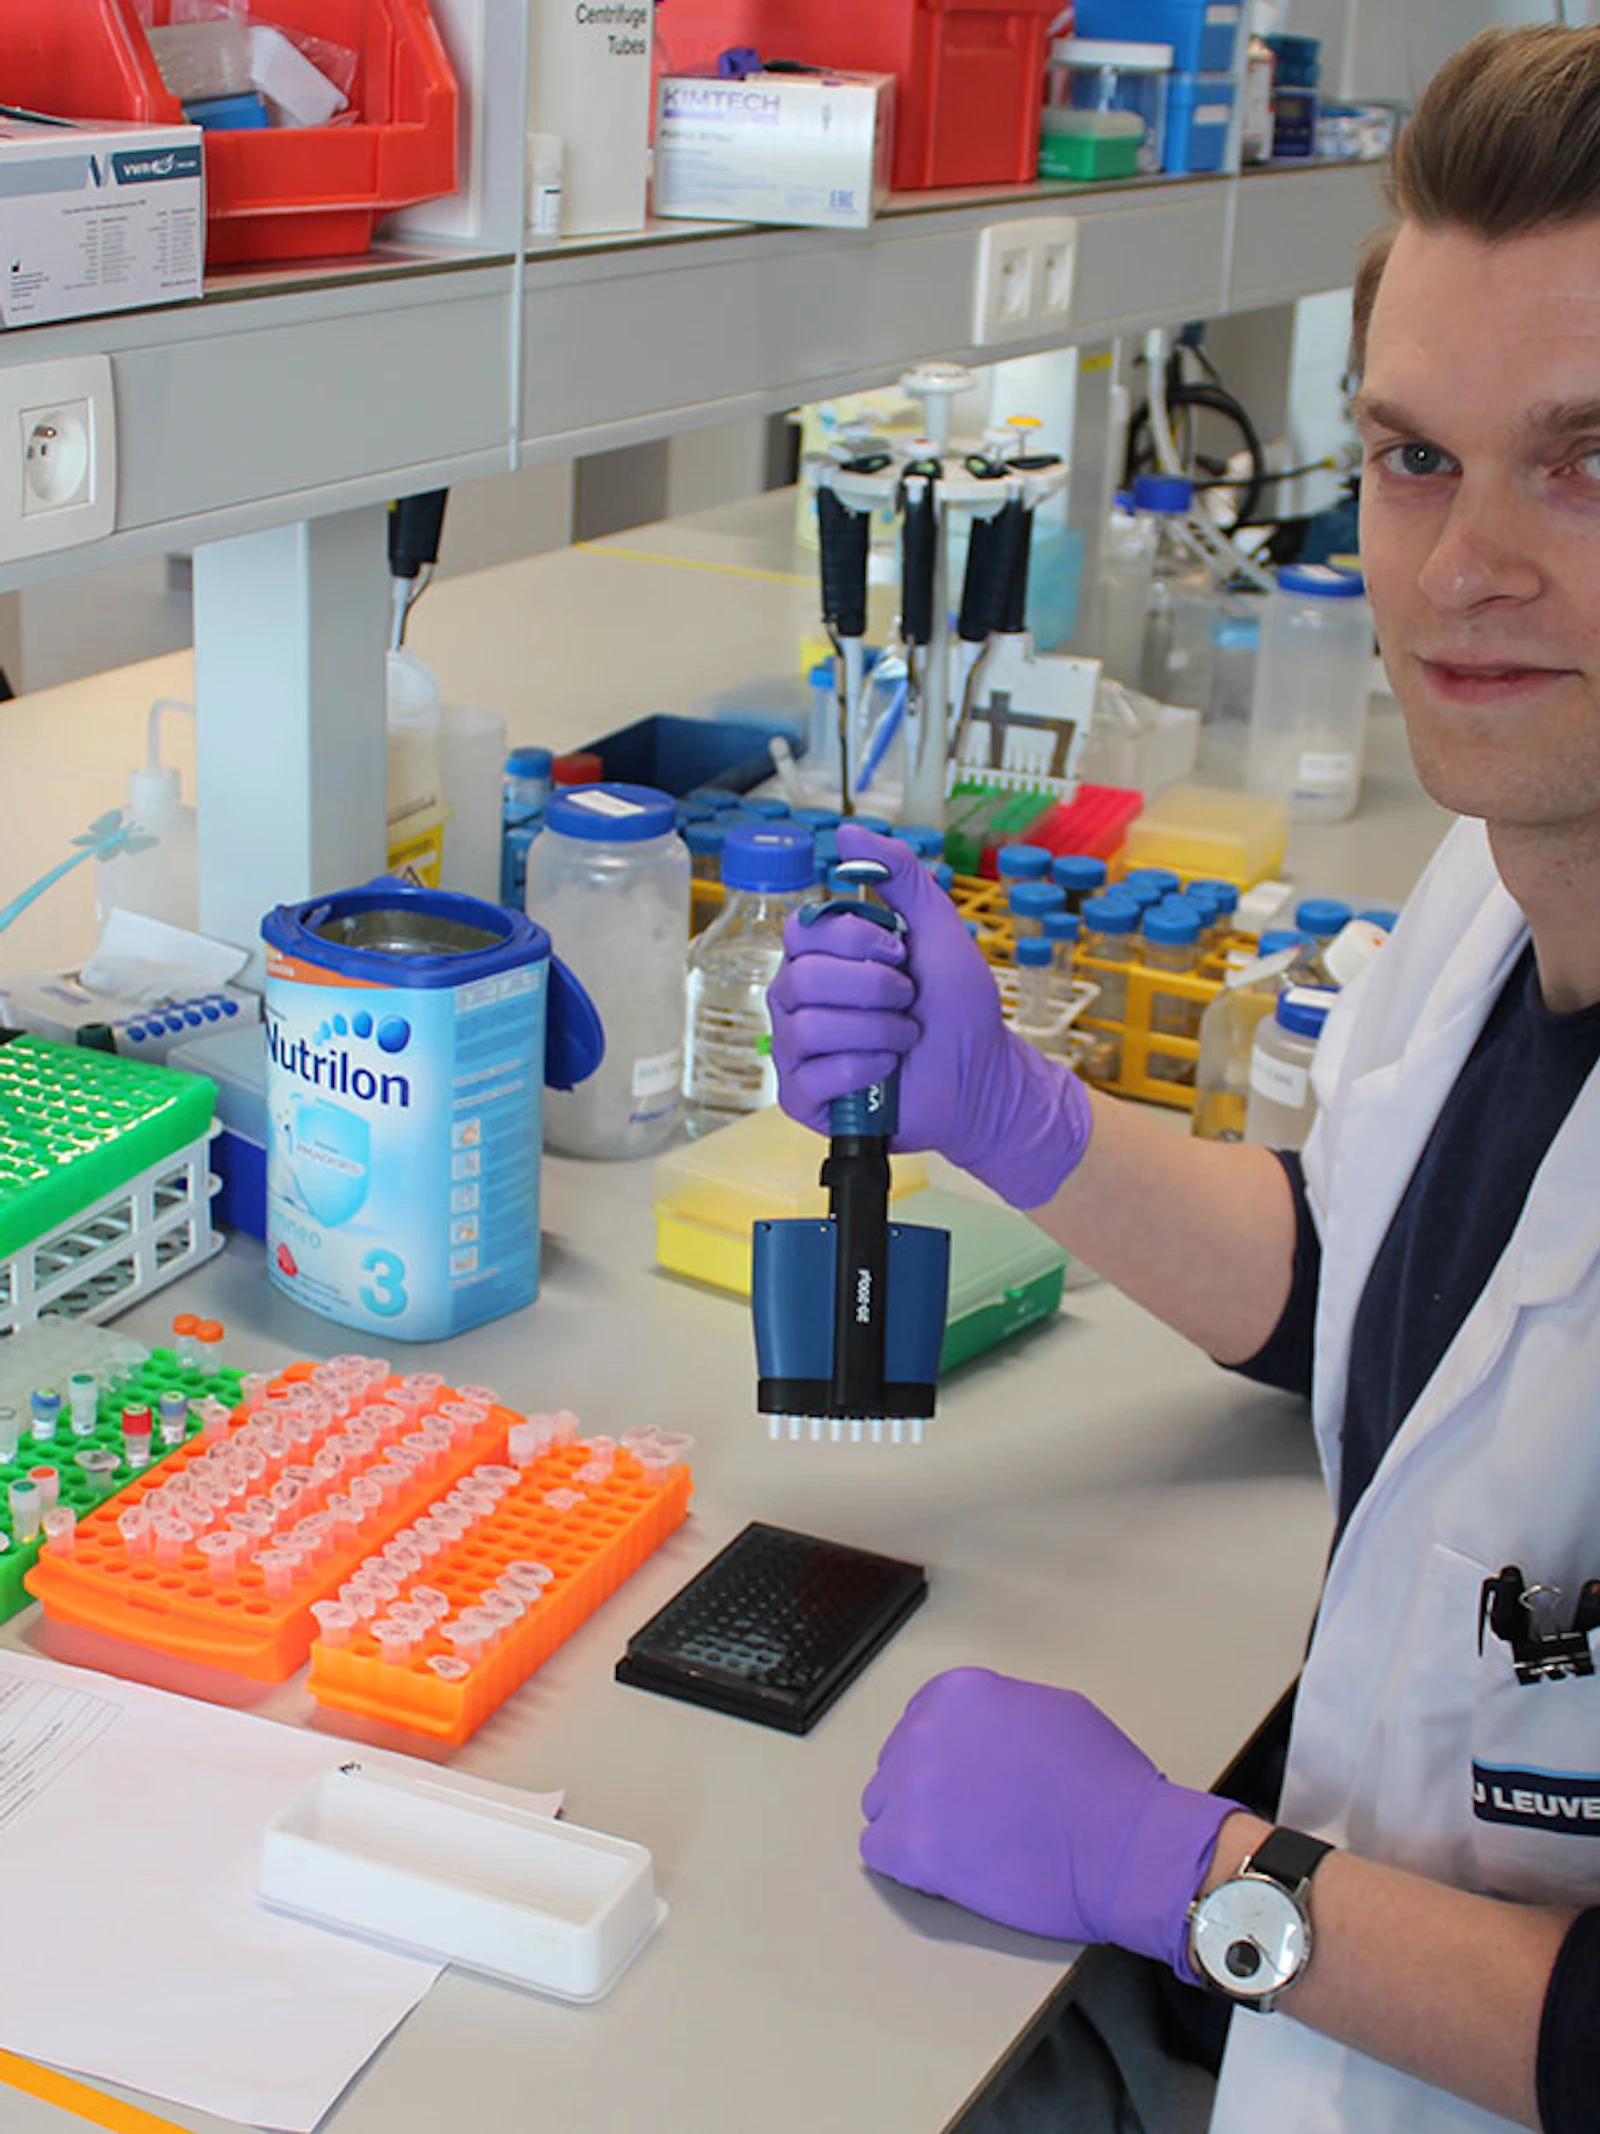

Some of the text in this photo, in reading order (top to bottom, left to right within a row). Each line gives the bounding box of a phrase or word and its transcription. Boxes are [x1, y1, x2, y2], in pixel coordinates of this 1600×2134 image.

[576, 3, 647, 28] Centrifuge
[607, 34, 646, 55] Tubes
[664, 87, 780, 110] KIMTECH
[264, 1016, 409, 1108] Nutrilon
[358, 1248, 409, 1318] 3
[1491, 1785, 1600, 1820] LEUVE
